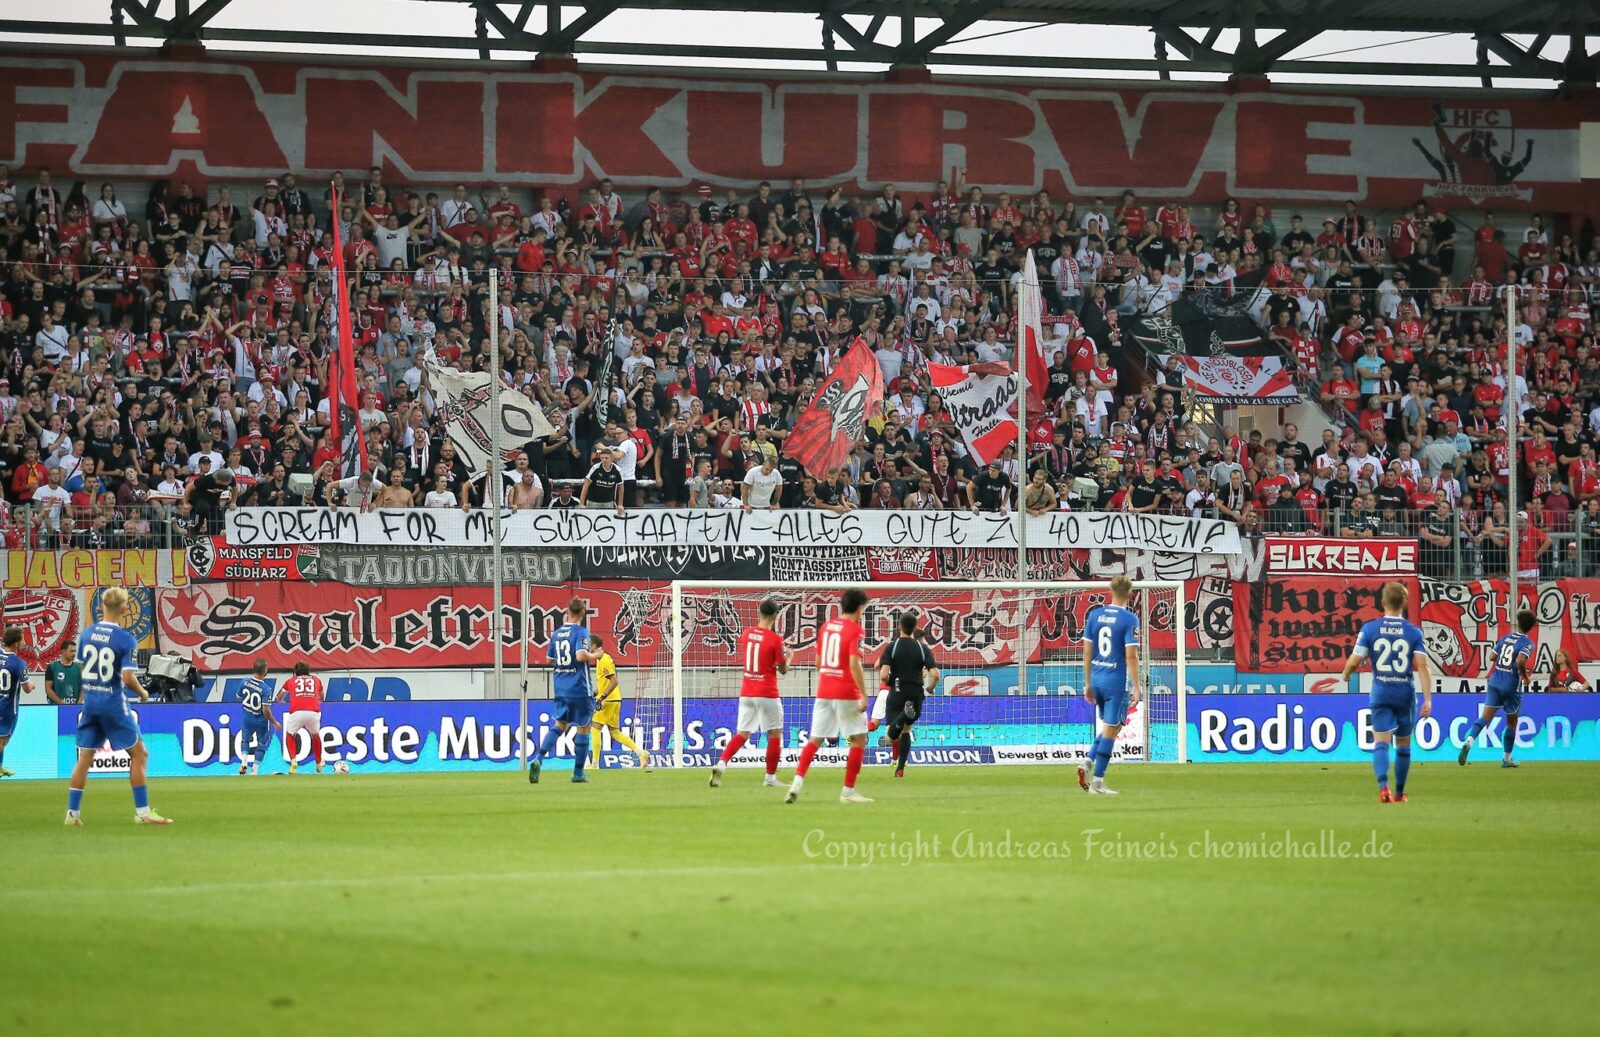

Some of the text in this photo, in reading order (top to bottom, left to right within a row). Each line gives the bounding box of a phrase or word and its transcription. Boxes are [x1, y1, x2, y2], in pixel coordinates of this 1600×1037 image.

[0, 57, 1366, 201] FANKURVE
[1453, 110, 1499, 126] HFC
[1437, 183, 1518, 194] HFC-FANKURVE
[939, 381, 974, 400] Chemie
[1252, 397, 1265, 405] ZU
[1267, 396, 1301, 406] SIEGEN
[233, 508, 359, 545] SCREAM
[380, 512, 446, 544] FOR
[886, 512, 972, 545] GUTE
[1048, 514, 1080, 545] 40
[219, 547, 293, 560] MANSFELD
[771, 556, 867, 571] MONTAGSSPIELE
[1269, 544, 1415, 571] SURREALE
[225, 563, 288, 579] SÜDHARZ
[771, 569, 868, 582] NICHT AKZEPTIEREN
[773, 591, 1001, 652] Utras
[555, 639, 572, 666] 13
[821, 631, 841, 668] 10
[1098, 625, 1112, 658] 6
[81, 643, 116, 683] 28
[745, 640, 761, 673] 11
[1373, 637, 1410, 673] 23
[1499, 642, 1514, 667] 19
[0, 668, 12, 691] 0
[294, 678, 316, 693] 33
[241, 688, 262, 711] 20
[183, 713, 262, 765] Die
[282, 711, 420, 764] beste
[438, 711, 578, 762] Musik
[1200, 703, 1572, 752] Radio Bocken
[90, 756, 132, 771] rocken
[603, 753, 712, 768] PS UNON
[911, 749, 982, 764] UNION
[998, 750, 1049, 763] bewegt
[1051, 749, 1072, 760] die
